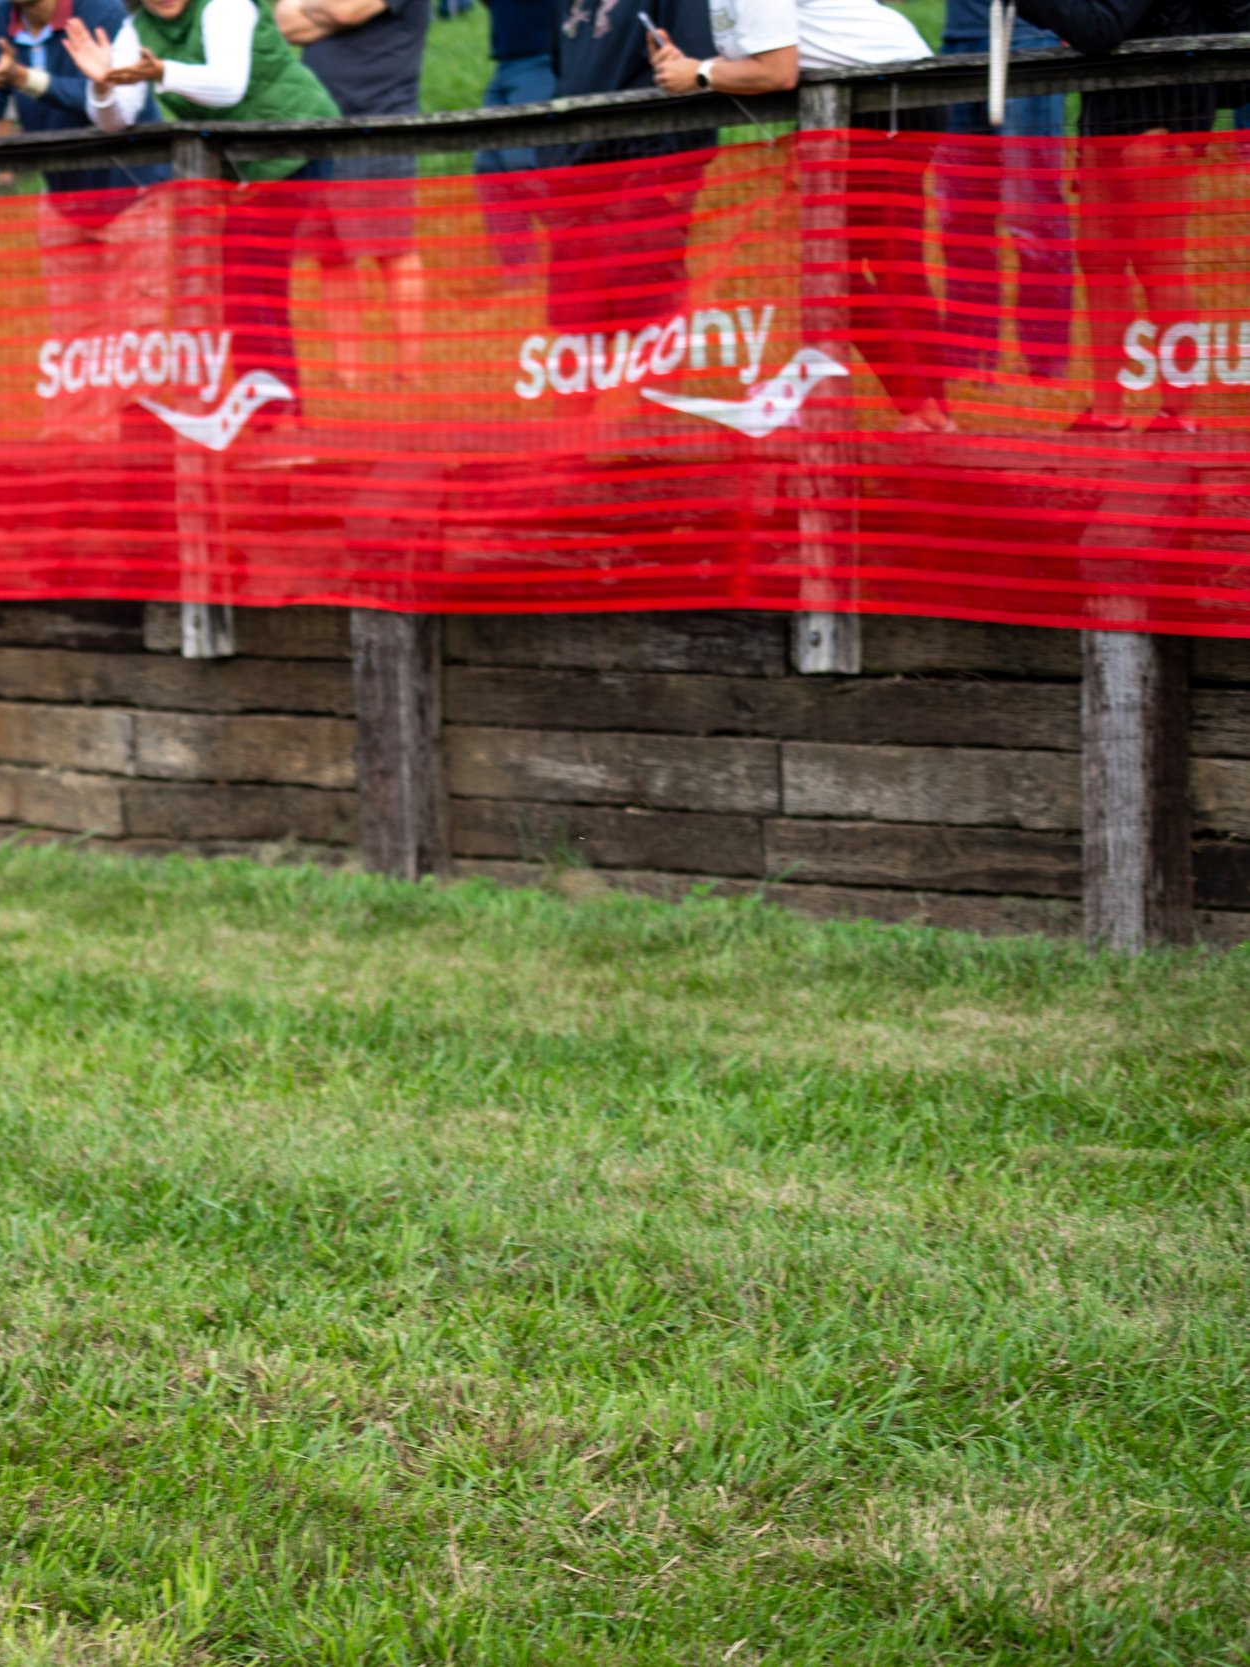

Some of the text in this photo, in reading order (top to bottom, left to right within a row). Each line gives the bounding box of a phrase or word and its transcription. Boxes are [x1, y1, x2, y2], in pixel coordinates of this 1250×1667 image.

[37, 329, 231, 402] saucony
[515, 304, 775, 398] saucony
[1116, 319, 1250, 391] sau
